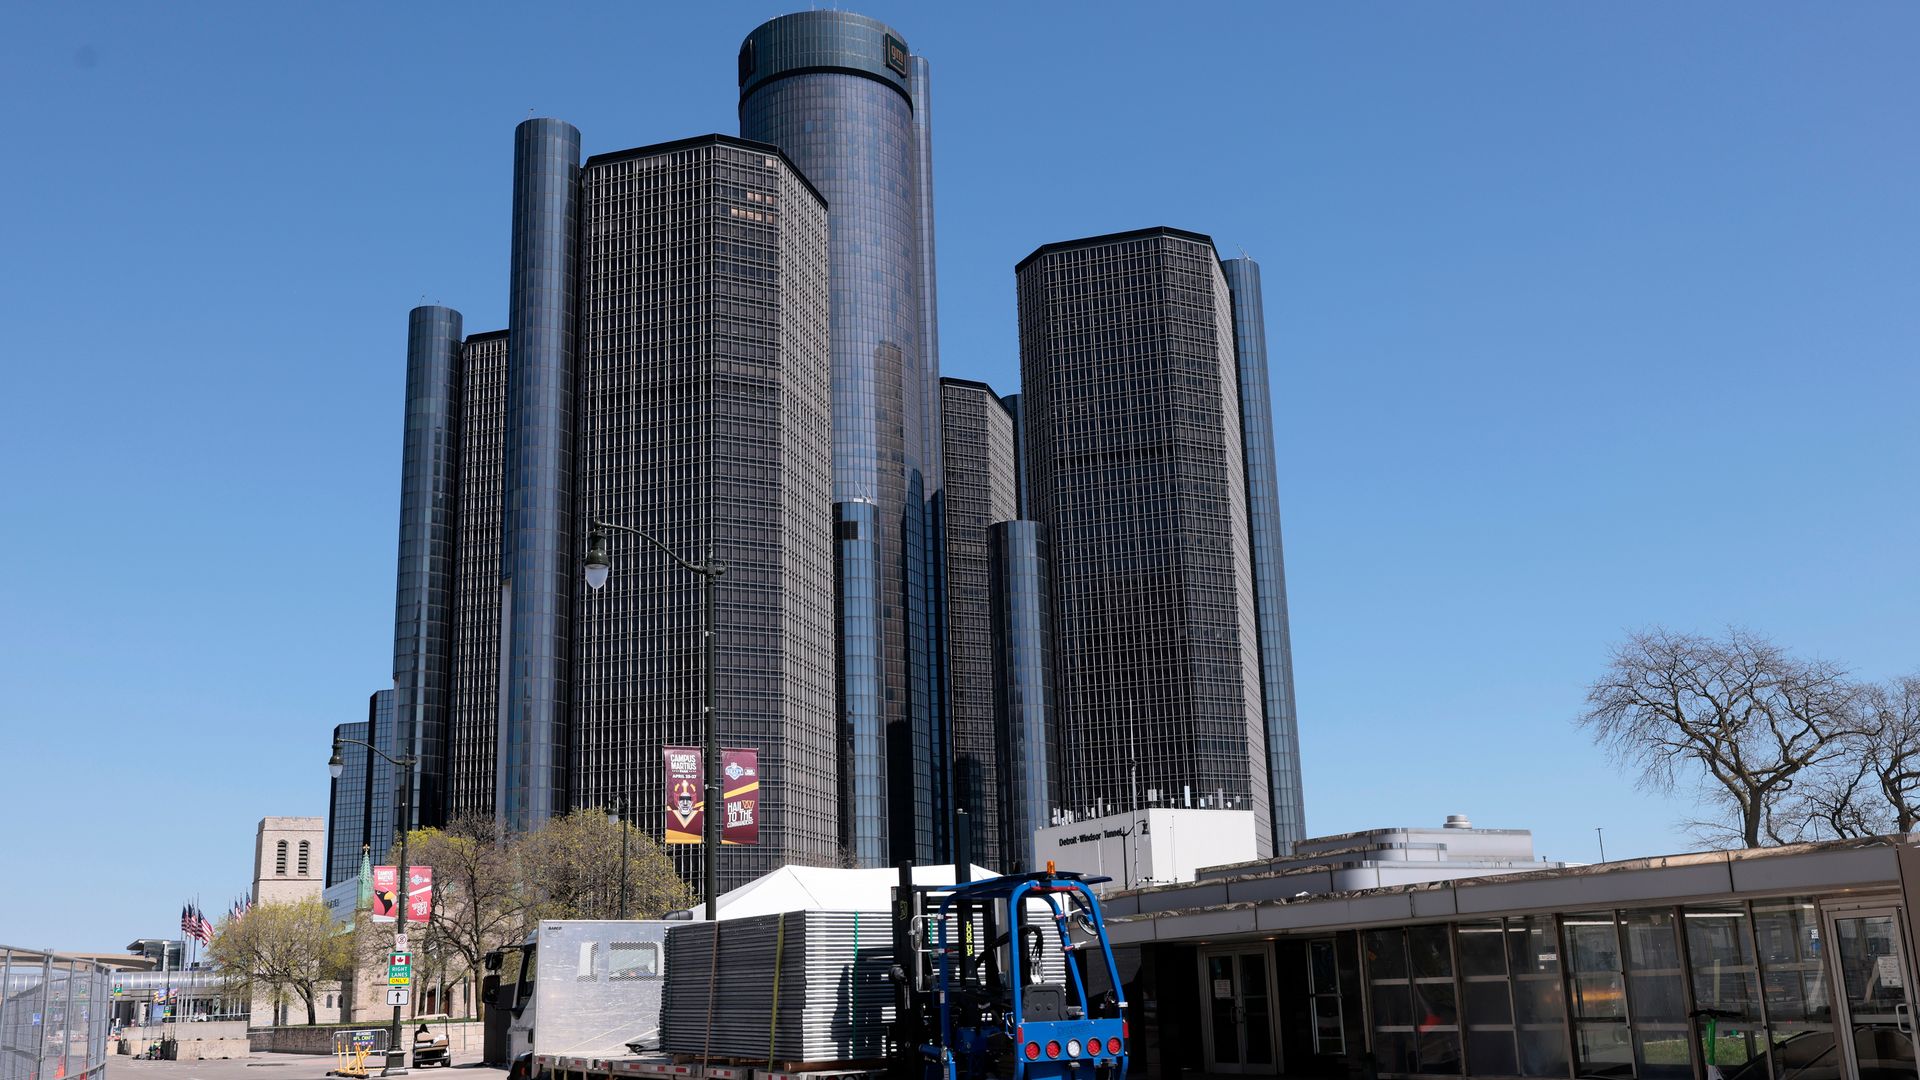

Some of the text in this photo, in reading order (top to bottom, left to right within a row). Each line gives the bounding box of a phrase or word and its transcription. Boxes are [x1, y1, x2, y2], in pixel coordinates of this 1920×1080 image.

[671, 754, 696, 763] CAMPUS
[671, 761, 697, 770] MARTIUS
[728, 801, 743, 813] HAIL
[728, 809, 754, 823] TO THE
[1104, 828, 1122, 839] Tunnel
[966, 945, 973, 957] UP
